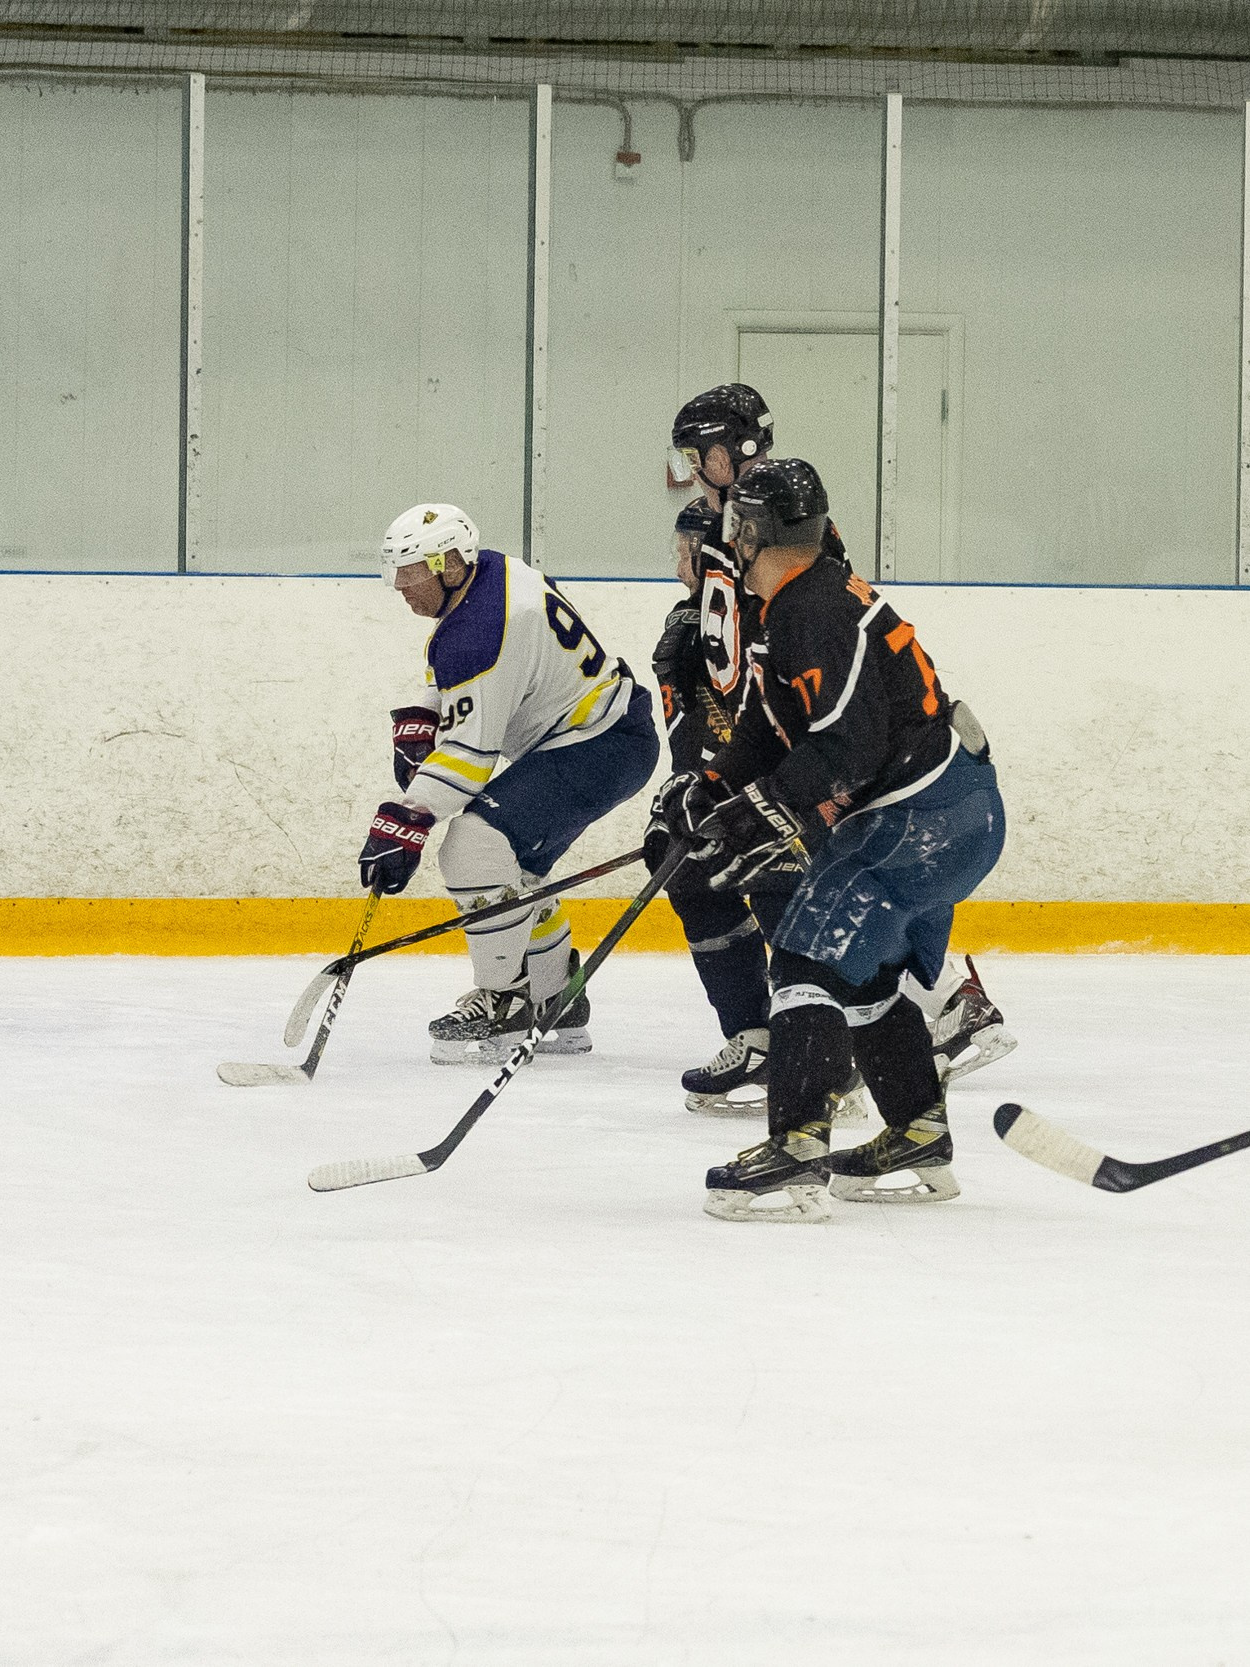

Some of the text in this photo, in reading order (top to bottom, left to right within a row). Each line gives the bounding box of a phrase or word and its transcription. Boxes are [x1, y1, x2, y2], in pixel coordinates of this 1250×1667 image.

[790, 667, 823, 716] 17
[392, 723, 436, 737] UER
[321, 976, 348, 1032] CCM
[488, 1025, 543, 1098] CCM
